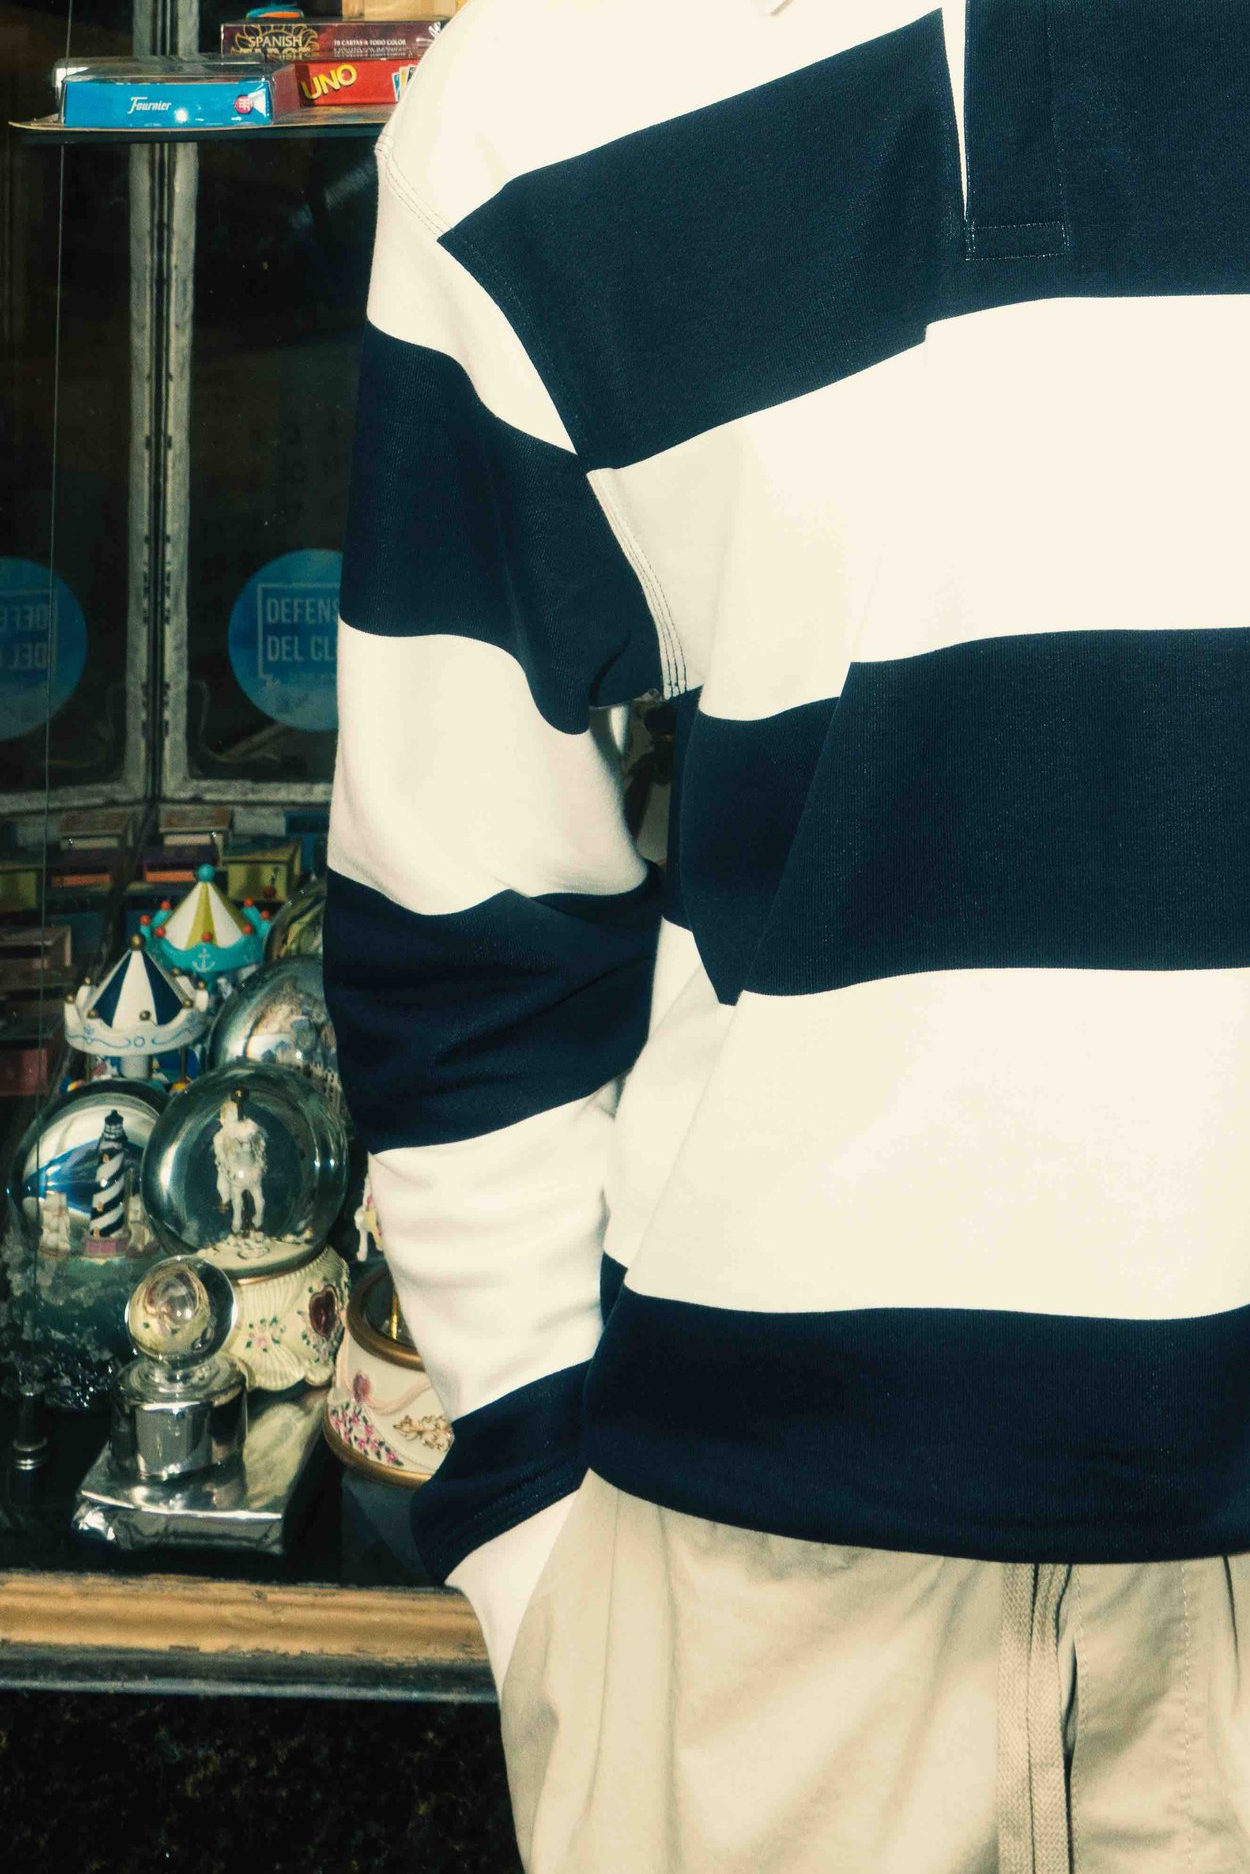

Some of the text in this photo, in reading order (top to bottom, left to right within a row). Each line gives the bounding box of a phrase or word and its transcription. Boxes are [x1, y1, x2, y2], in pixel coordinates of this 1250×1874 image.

[248, 36, 303, 48] SPANISH
[302, 63, 357, 101] UNO
[127, 96, 172, 114] Fournier
[266, 634, 337, 663] DEL CL
